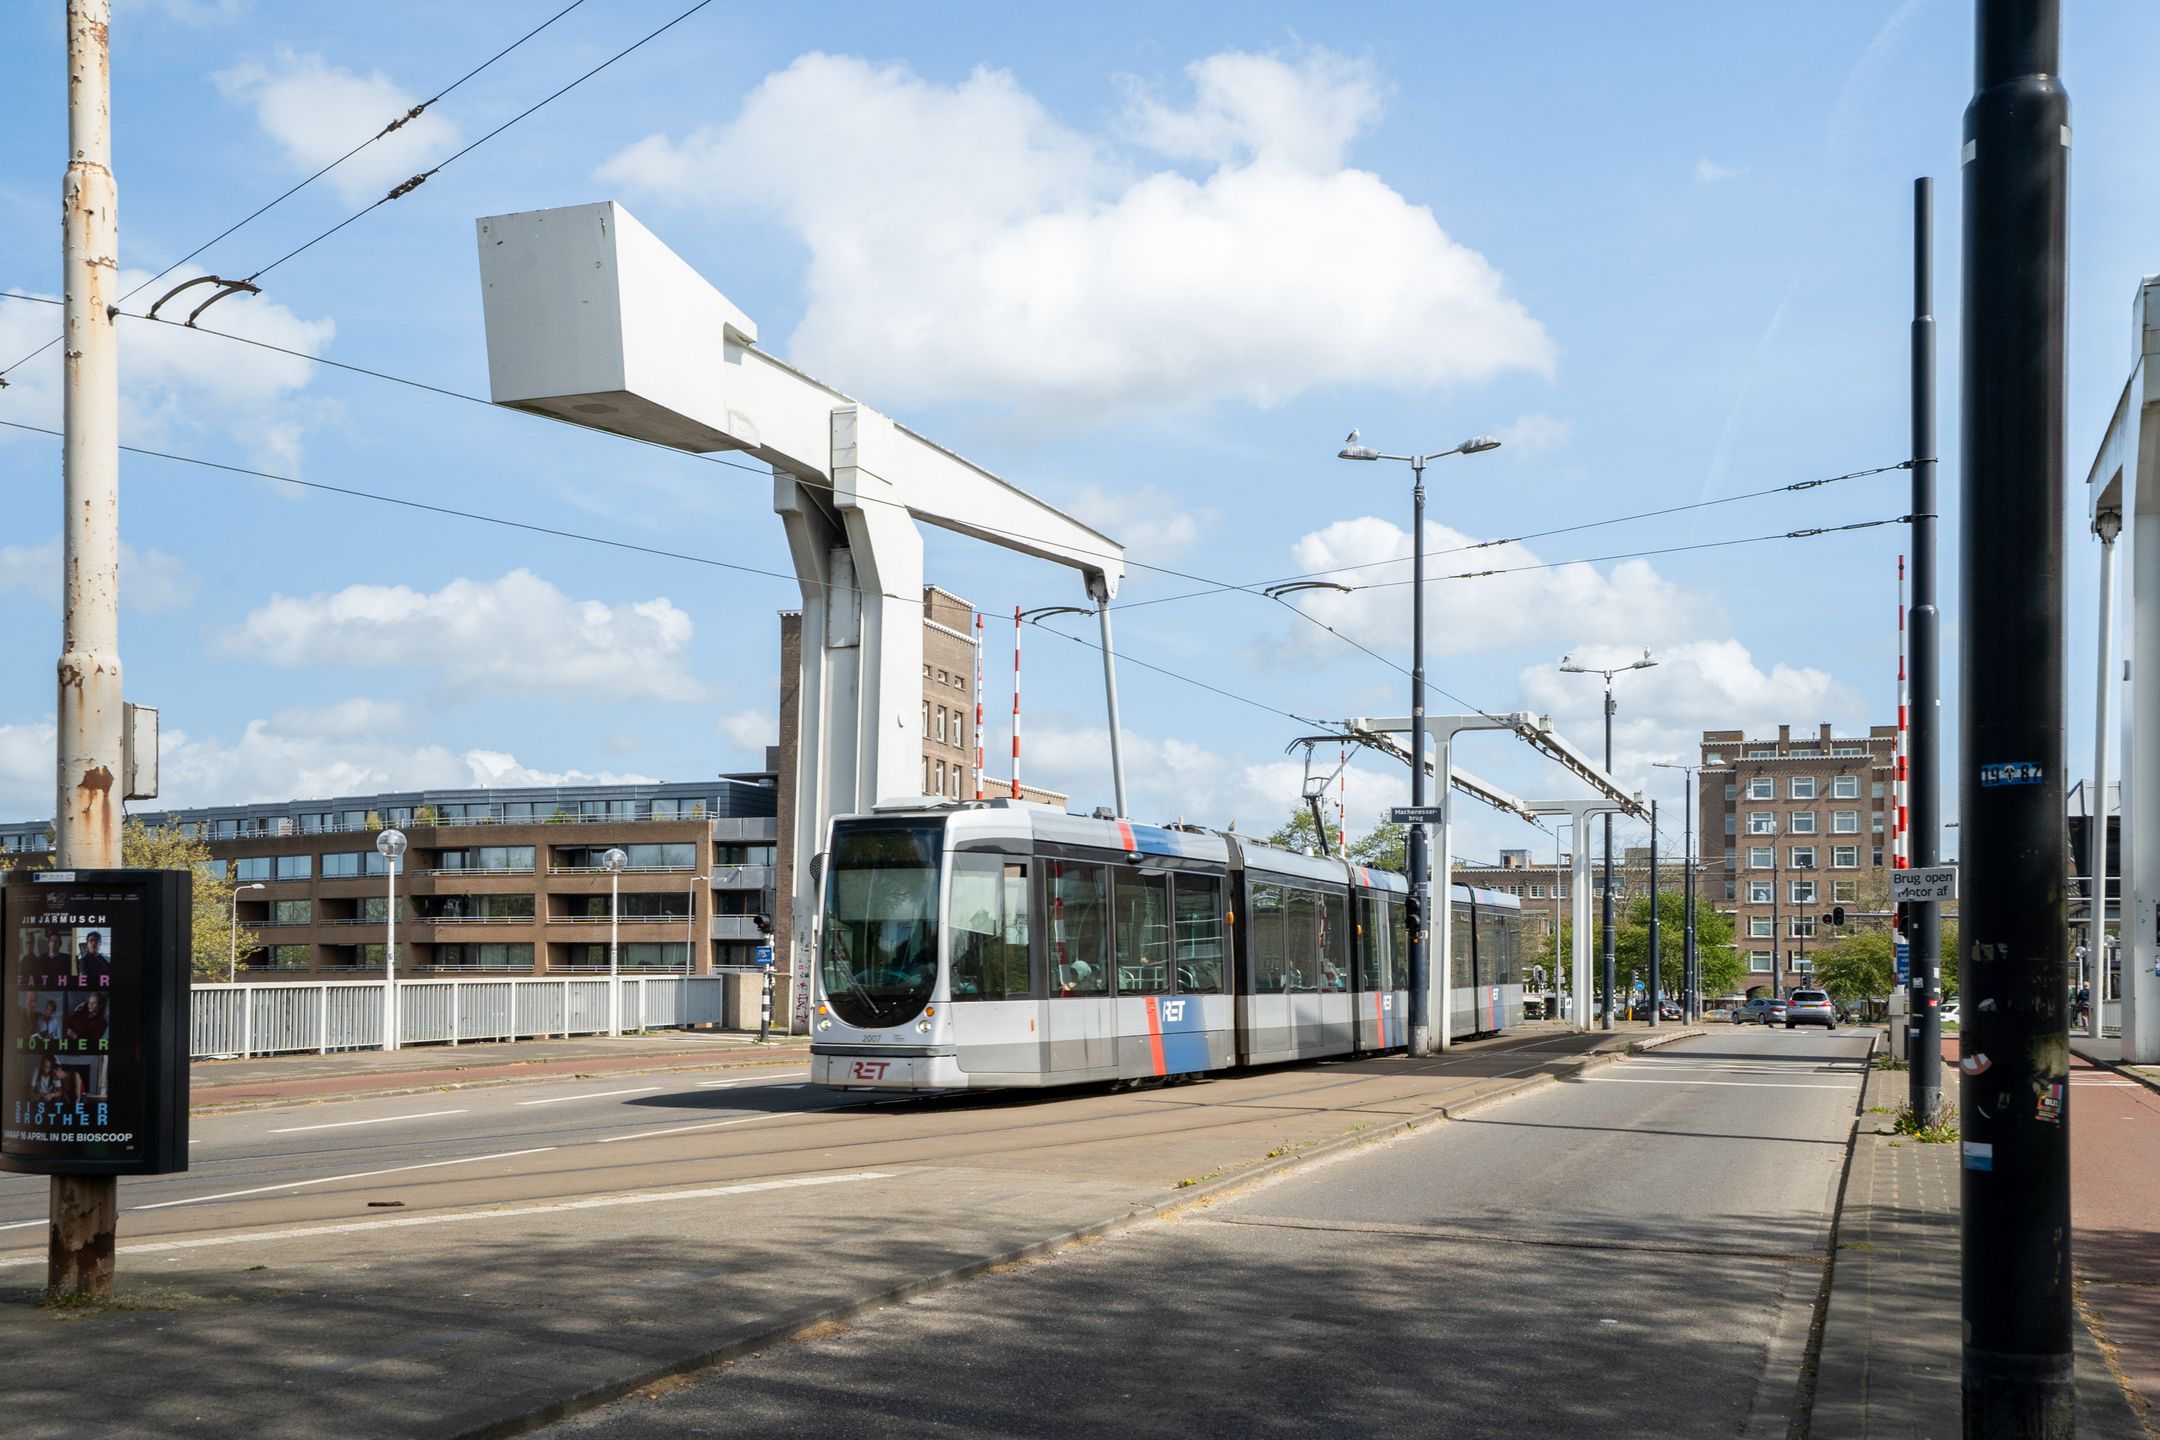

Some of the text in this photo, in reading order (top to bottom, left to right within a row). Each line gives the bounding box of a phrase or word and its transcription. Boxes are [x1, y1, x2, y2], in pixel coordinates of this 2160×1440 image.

[1893, 873, 1953, 885] Brug open
[1898, 885, 1949, 898] Motor af
[22, 915, 106, 924] JIM JARMUSCH
[16, 974, 110, 987] FATHER
[1162, 1000, 1186, 1022] RET
[16, 1038, 109, 1051] MOTHER
[862, 1034, 882, 1043] 2007
[848, 1061, 891, 1080] RET
[15, 1100, 108, 1115] SISTER
[15, 1111, 108, 1126] BROTHER
[27, 1132, 48, 1141] APRIL
[49, 1133, 59, 1142] IN
[61, 1133, 74, 1142] DE
[76, 1133, 133, 1142] BIOSCOOP
